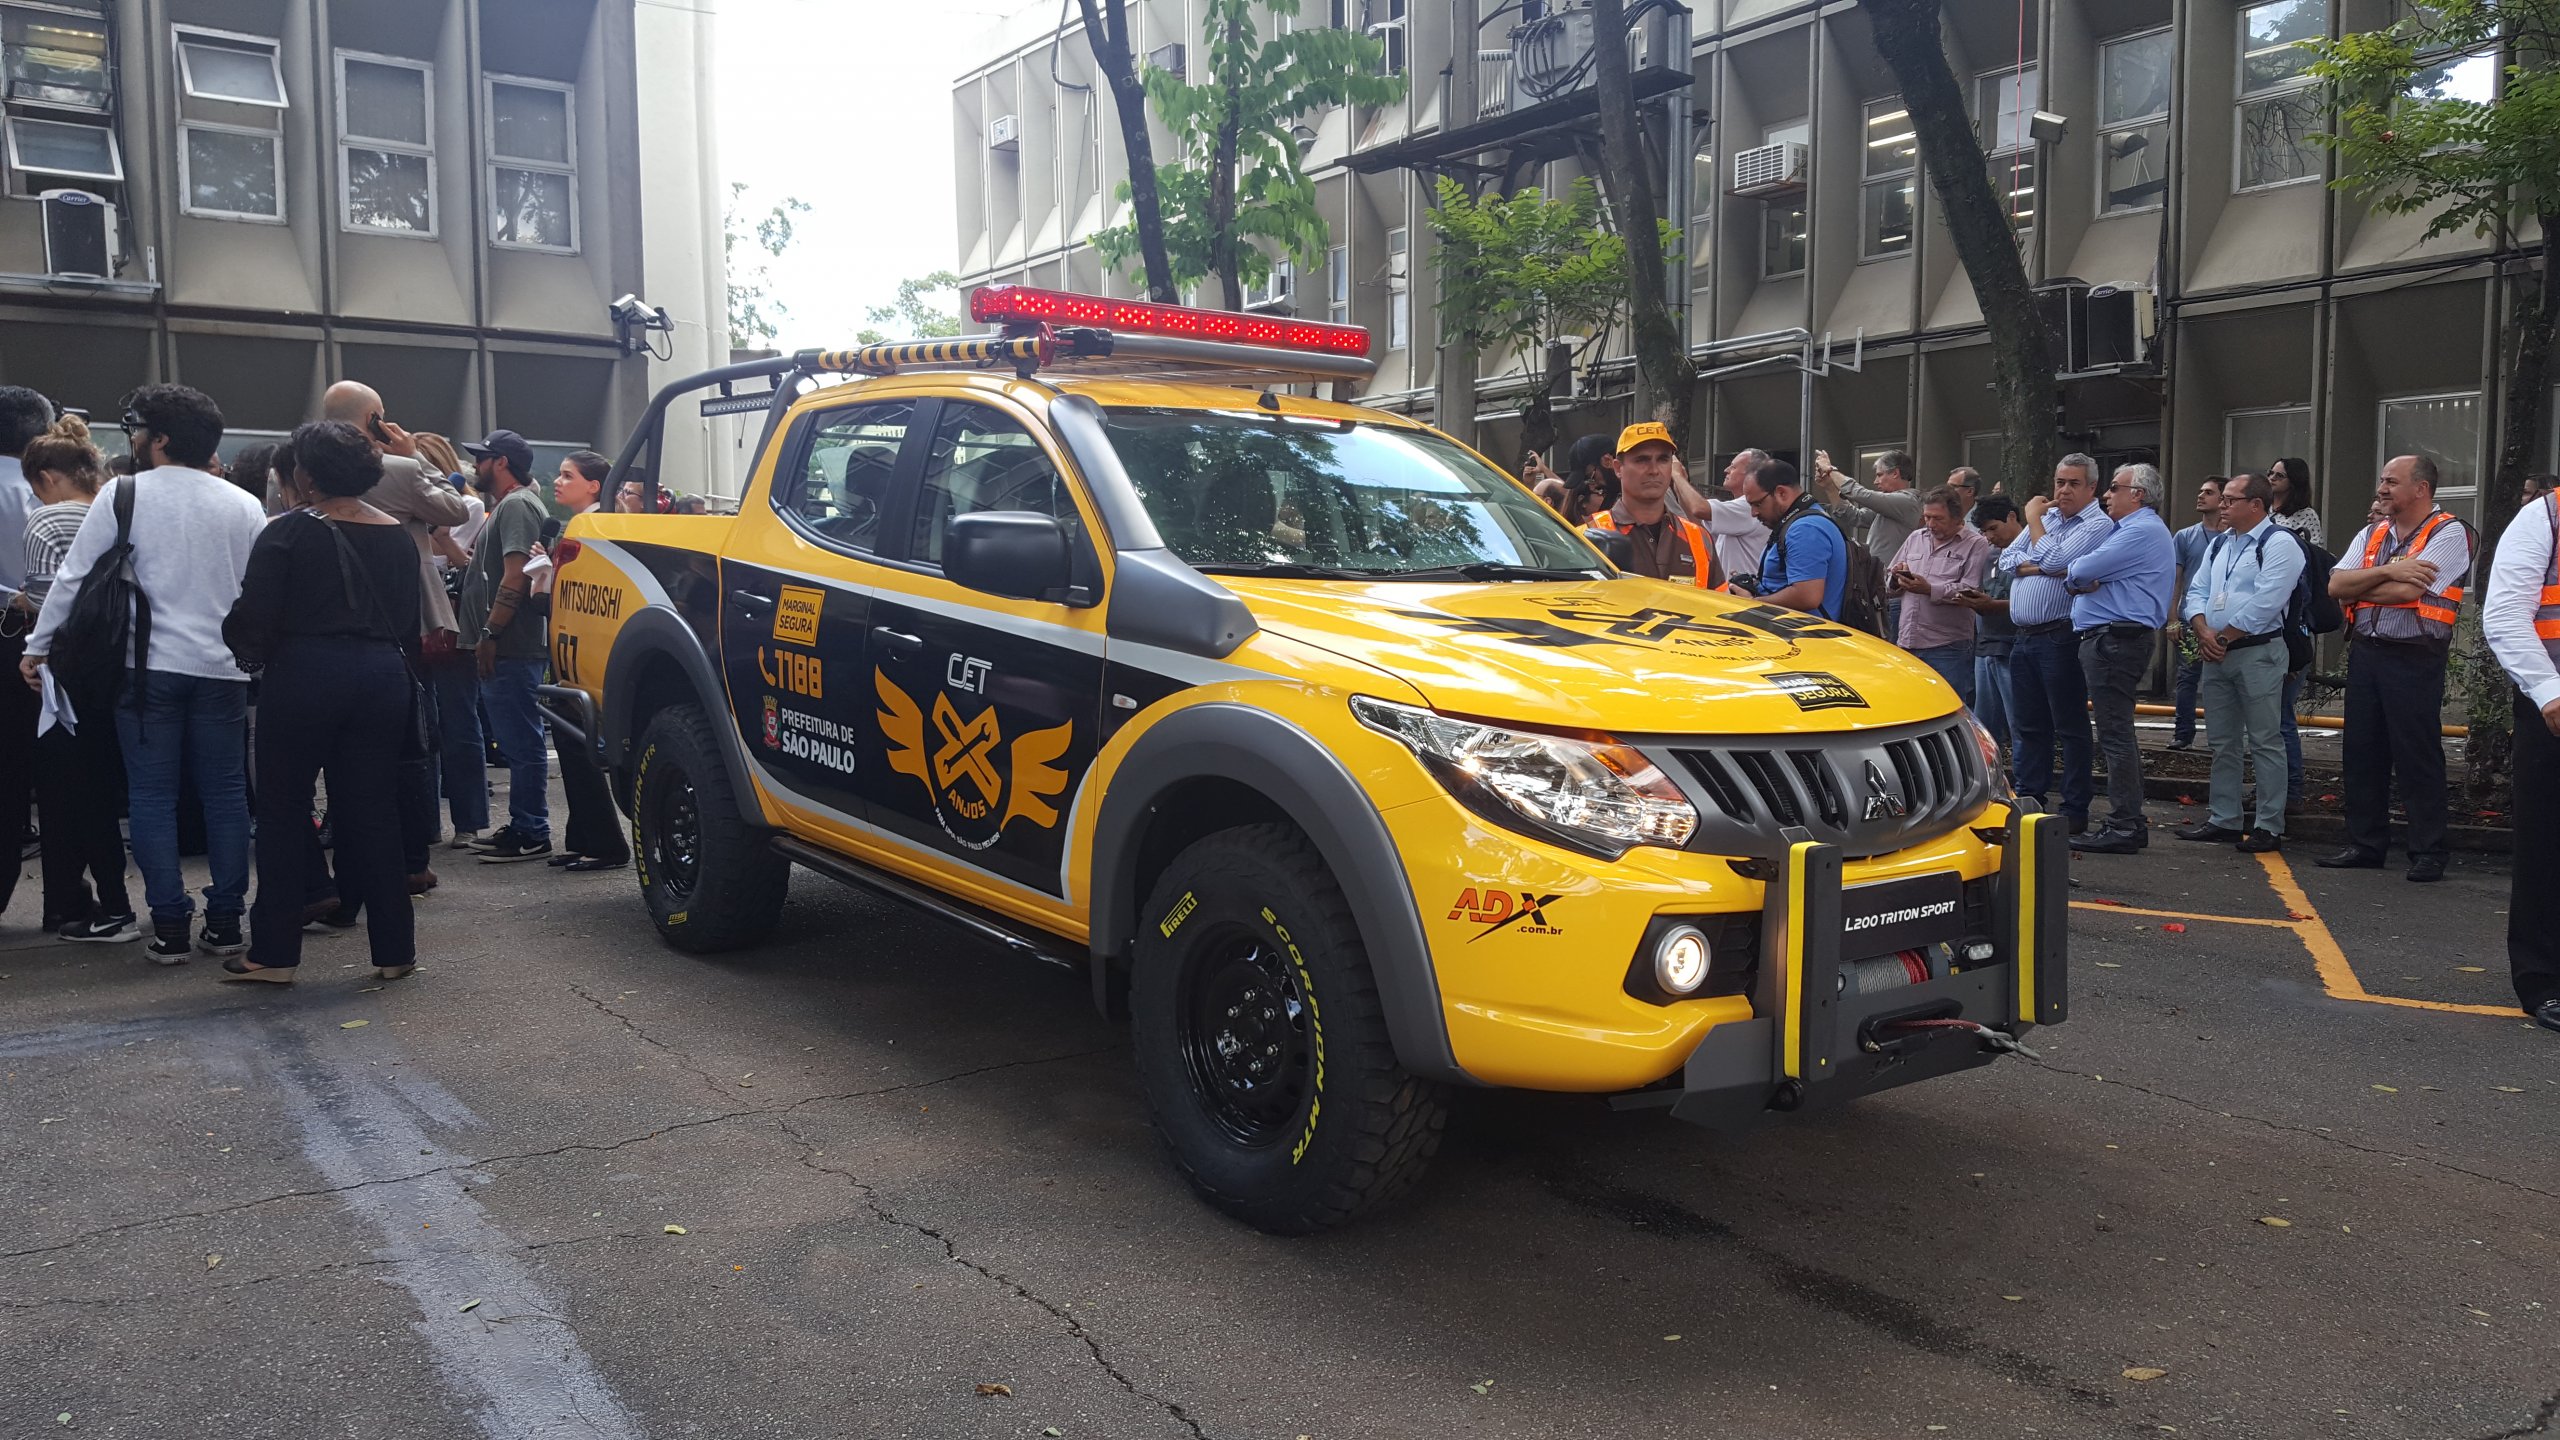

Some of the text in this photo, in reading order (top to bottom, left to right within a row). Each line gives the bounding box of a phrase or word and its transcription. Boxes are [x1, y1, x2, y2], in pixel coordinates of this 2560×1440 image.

[62, 194, 87, 203] Carrier
[2094, 288, 2115, 296] Carrier
[559, 579, 622, 620] MITSUBISHI
[782, 598, 816, 615] MARGINAL
[779, 614, 813, 634] SEGURA
[557, 632, 579, 684] 01
[774, 648, 823, 699] 1188
[947, 652, 993, 695] CET
[1794, 686, 1856, 701] SEGURA
[781, 707, 855, 745] PREFEITURA DE
[782, 728, 855, 774] SÃO PAULO
[633, 743, 656, 886] SCORPION MTR
[948, 788, 987, 819] ANJOS
[1160, 891, 1198, 938] PIRELLI
[1447, 887, 1565, 944] ADX
[1516, 925, 1563, 936] .com.br
[1844, 900, 1956, 932] L200 TRITON SPORT
[1260, 906, 1325, 1166] SCORPION MTR
